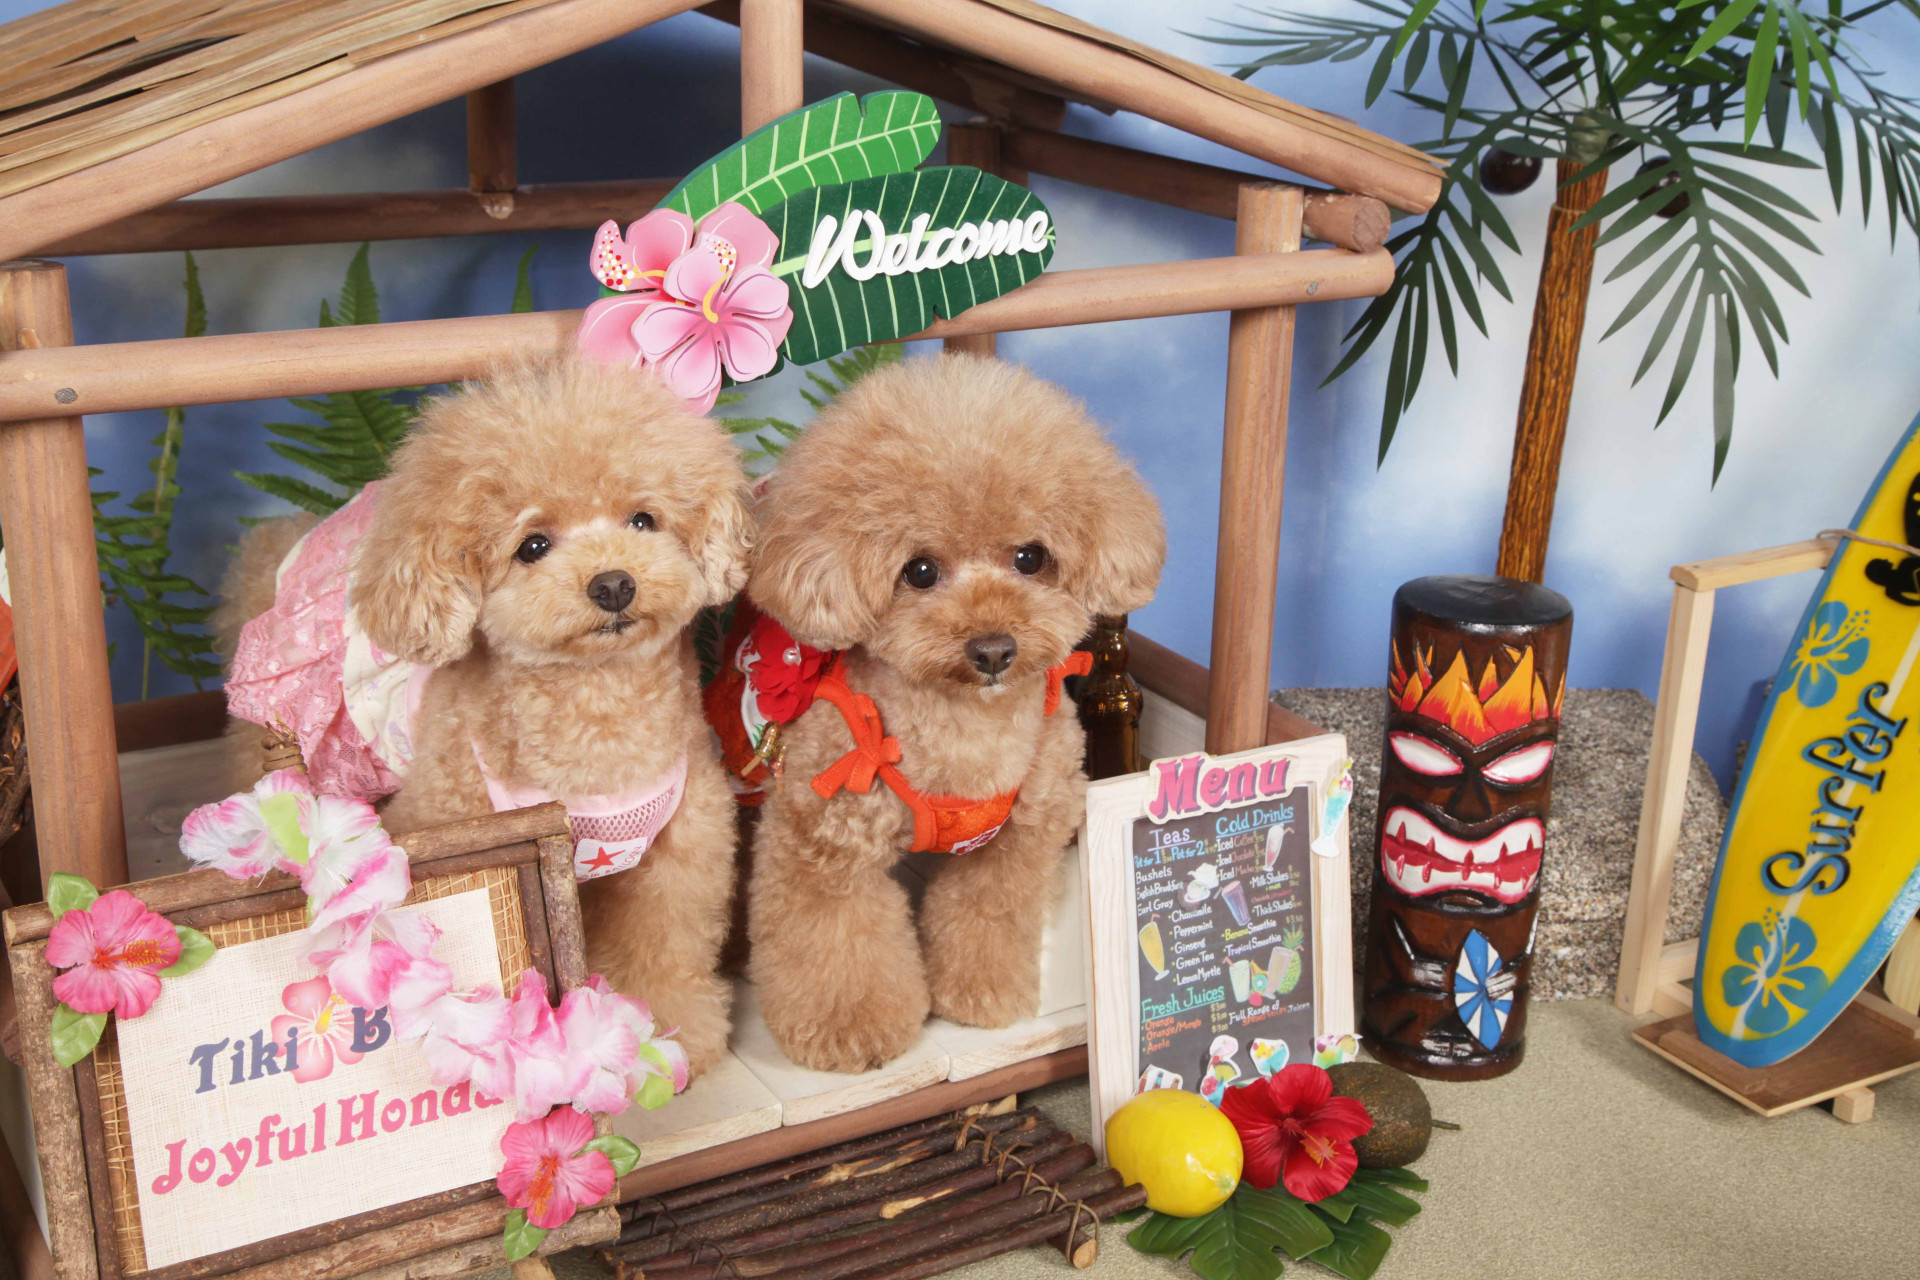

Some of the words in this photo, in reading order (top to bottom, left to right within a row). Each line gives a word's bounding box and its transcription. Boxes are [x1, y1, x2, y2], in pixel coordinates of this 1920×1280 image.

[802, 208, 1049, 289] Welcome
[1149, 754, 1291, 818] Menu
[1760, 681, 1908, 895] Surfer
[1215, 811, 1250, 835] Cold
[1252, 803, 1294, 826] Drinks
[1149, 828, 1191, 849] Teas
[1216, 837, 1233, 852] Iced
[1136, 866, 1173, 884] Bushels
[1174, 938, 1206, 954] Ginseng
[1141, 993, 1181, 1023] Fresh
[1183, 985, 1224, 1007] Juices
[188, 1026, 300, 1095] Tiki
[151, 1101, 327, 1196] Joyful
